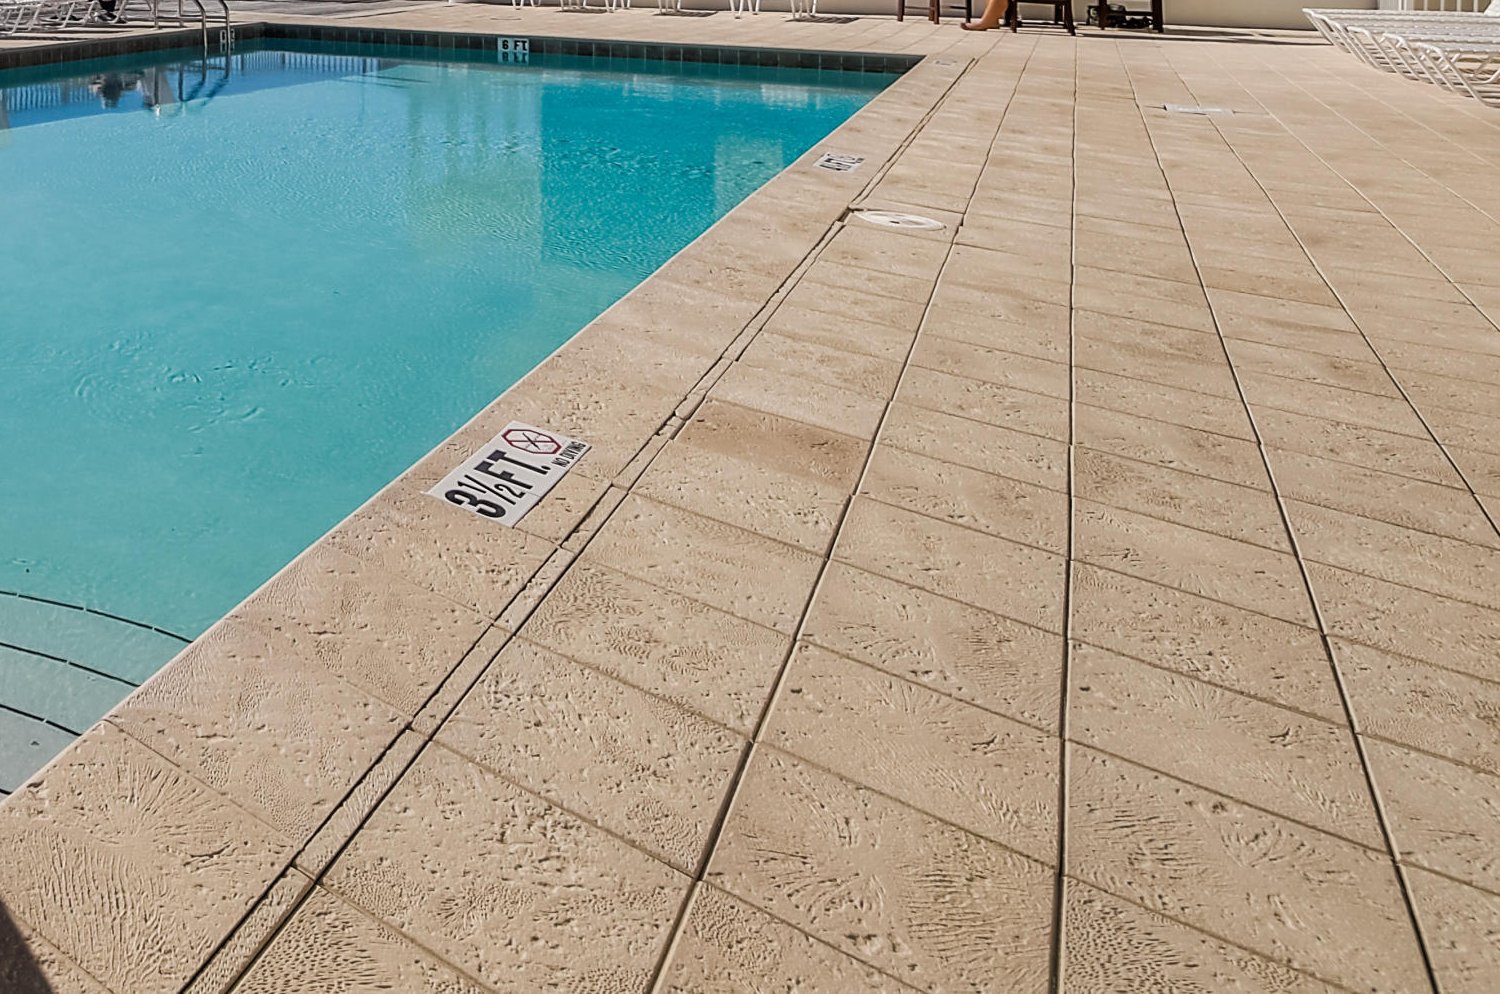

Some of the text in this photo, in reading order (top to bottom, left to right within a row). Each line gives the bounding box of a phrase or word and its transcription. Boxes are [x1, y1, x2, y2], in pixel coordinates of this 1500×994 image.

[502, 39, 509, 50] 6
[551, 441, 587, 468] NO DIVING
